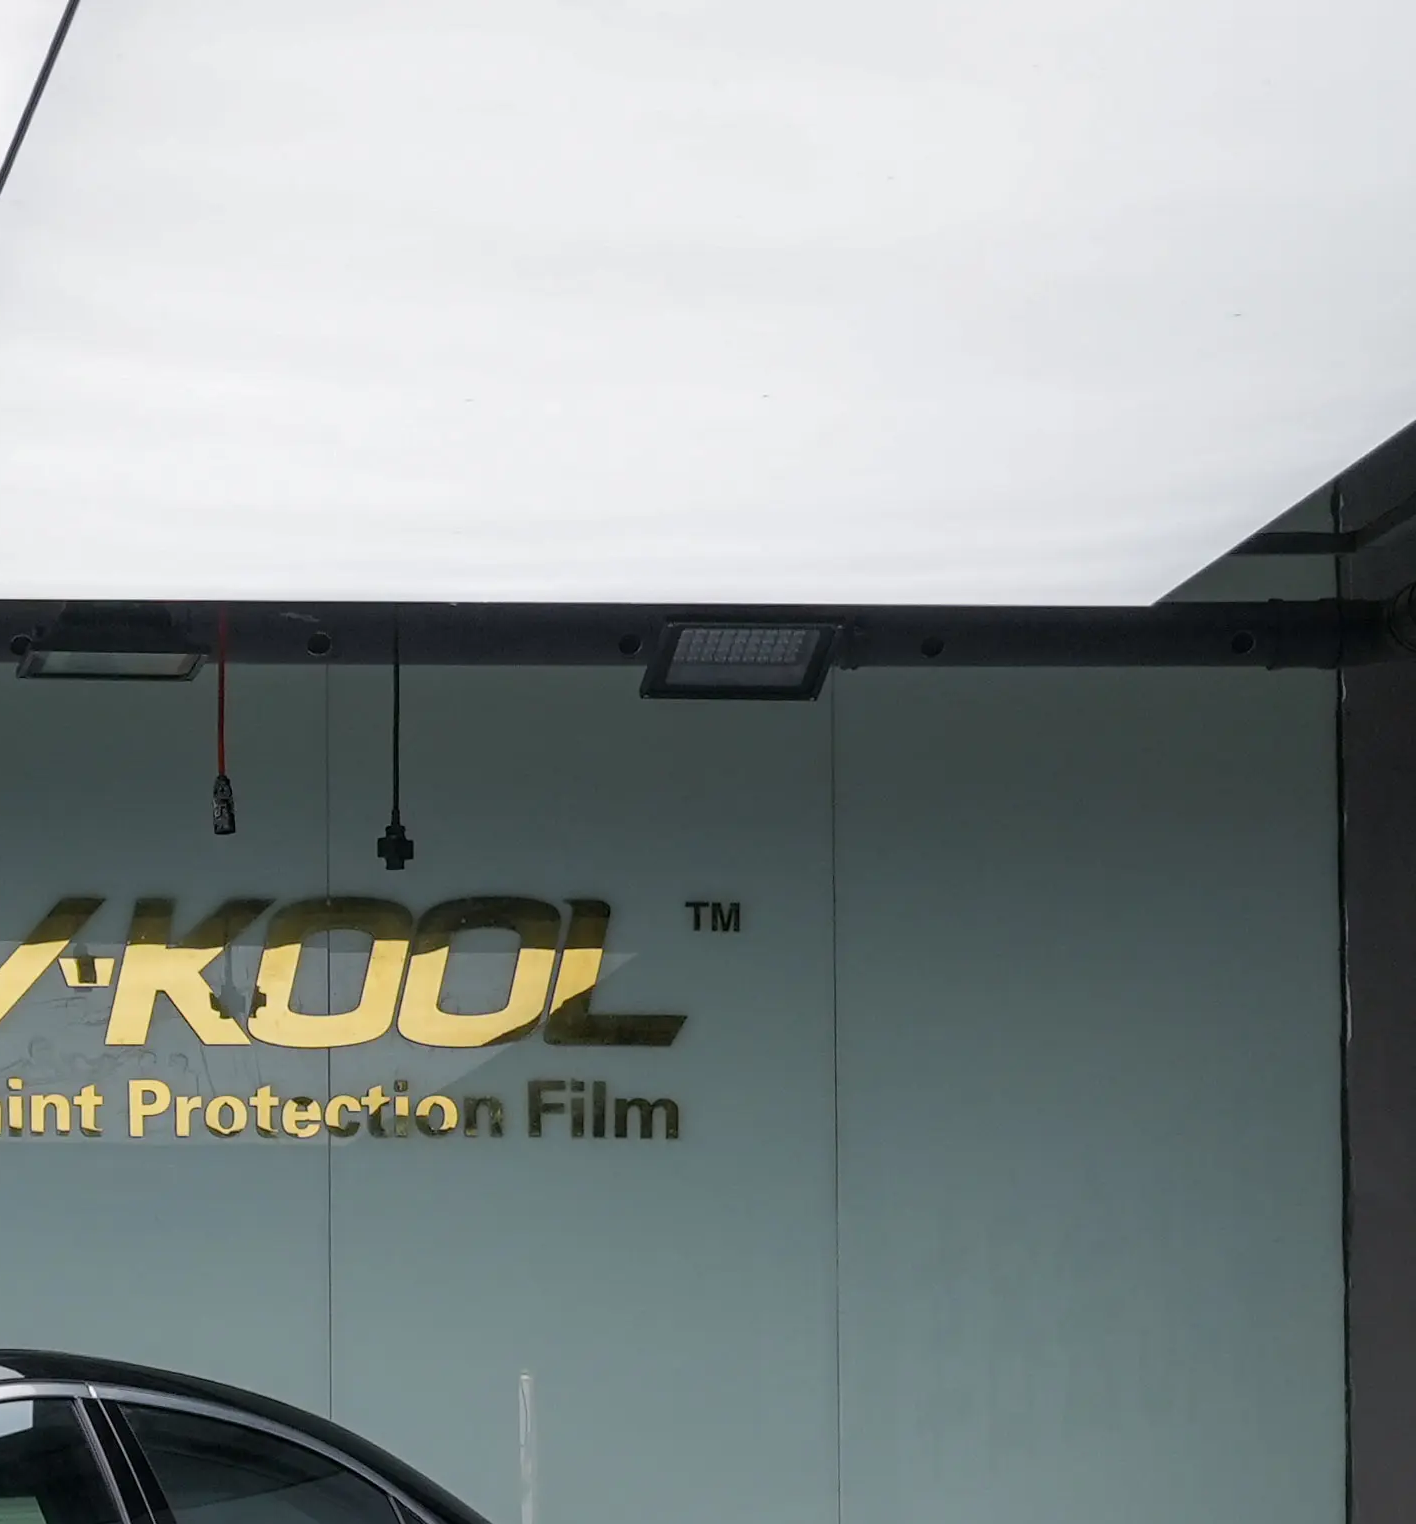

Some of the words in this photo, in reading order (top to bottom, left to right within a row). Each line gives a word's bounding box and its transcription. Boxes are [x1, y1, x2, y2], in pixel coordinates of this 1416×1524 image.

[684, 900, 743, 934] TM
[127, 1077, 507, 1140] Protection
[527, 1078, 682, 1141] Film
